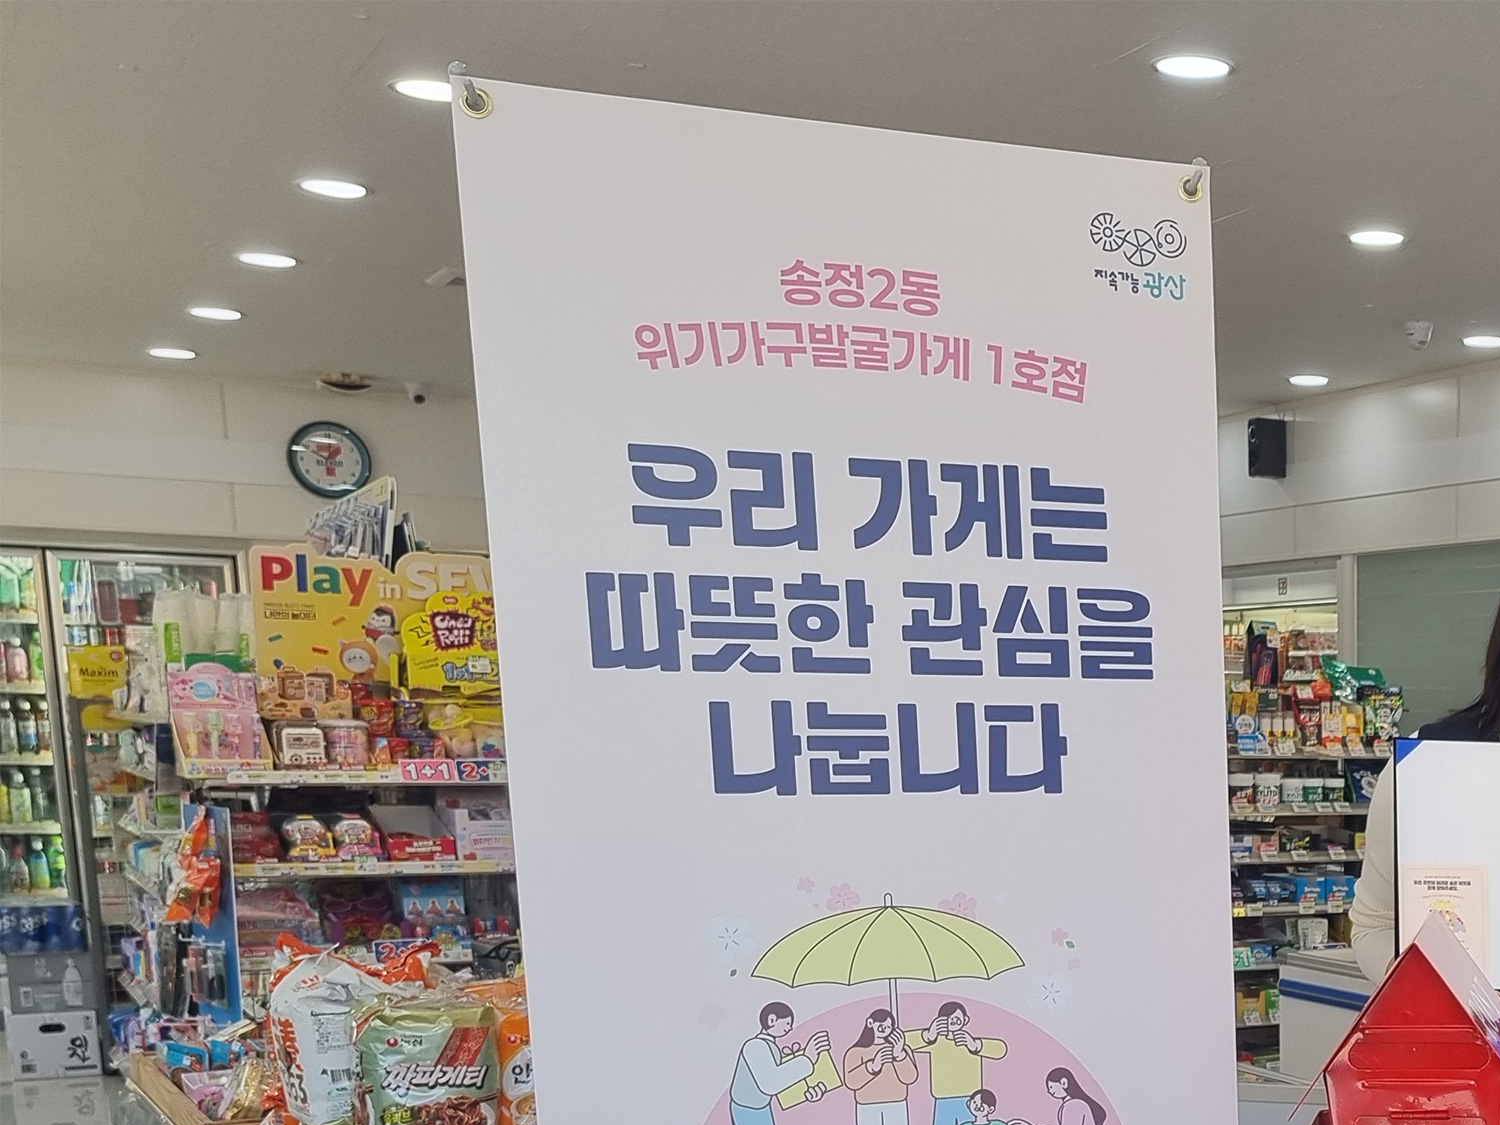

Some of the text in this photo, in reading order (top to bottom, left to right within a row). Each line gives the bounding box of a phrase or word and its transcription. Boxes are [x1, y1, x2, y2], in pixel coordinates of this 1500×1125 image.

[779, 259, 941, 316] 송정2동
[1094, 269, 1186, 300] 지속가능 광산
[634, 323, 1089, 404] 위기가구발굴가게 1호점
[627, 443, 1109, 563] 우리 가게는
[260, 553, 373, 607] Play
[378, 578, 400, 600] in
[585, 571, 1155, 681] 따뜻한 관심을
[79, 667, 119, 679] Maxim
[403, 762, 451, 781] 1+1
[708, 701, 1070, 796] 나눕니다
